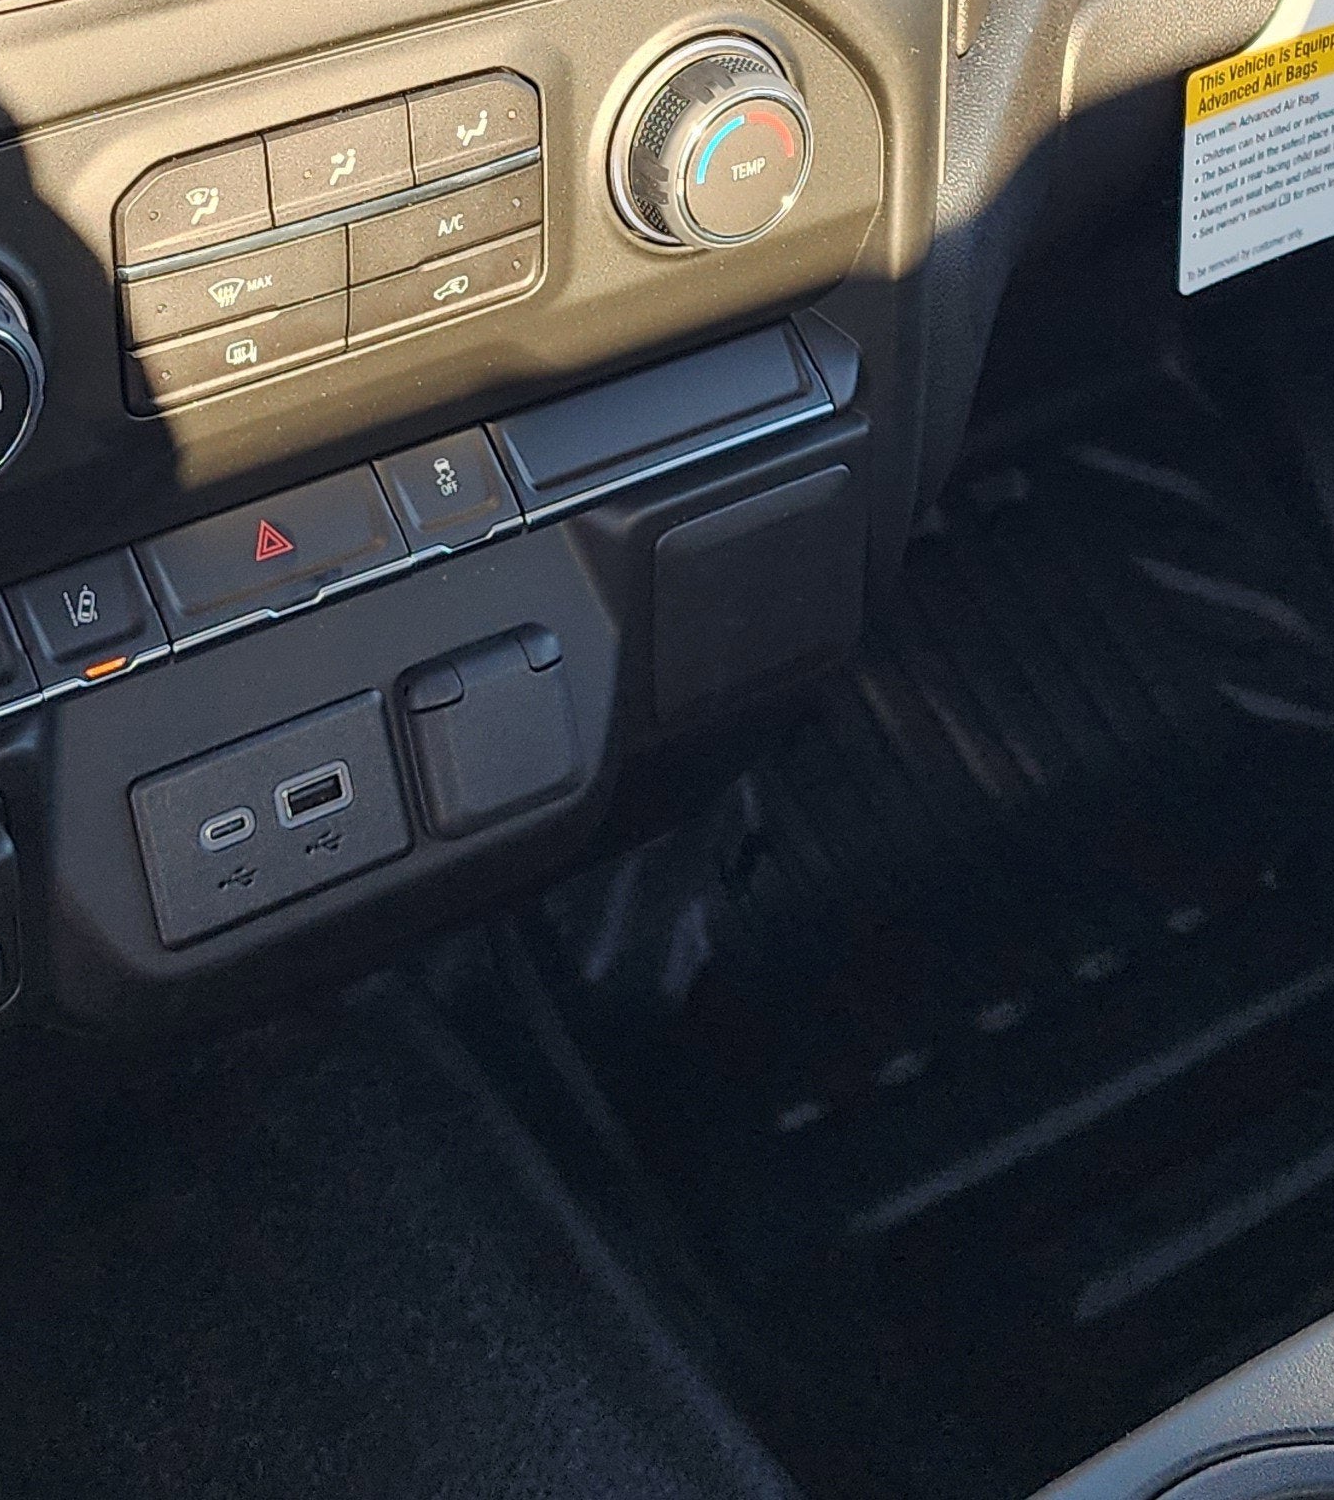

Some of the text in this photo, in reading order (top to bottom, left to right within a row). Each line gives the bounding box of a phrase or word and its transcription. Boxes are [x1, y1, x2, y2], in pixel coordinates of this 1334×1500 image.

[1199, 69, 1225, 93] This
[1228, 50, 1276, 81] Vehicle
[1278, 45, 1291, 64] is
[1197, 57, 1318, 116] Advanced Air Bags
[1218, 120, 1237, 136] with
[1238, 101, 1282, 128] Advanced
[1283, 97, 1295, 112] Air
[1297, 89, 1320, 108] Bags
[730, 156, 766, 182] TEMP
[438, 213, 464, 237] A/C
[246, 275, 273, 292] MAX
[440, 480, 458, 497] OFF
